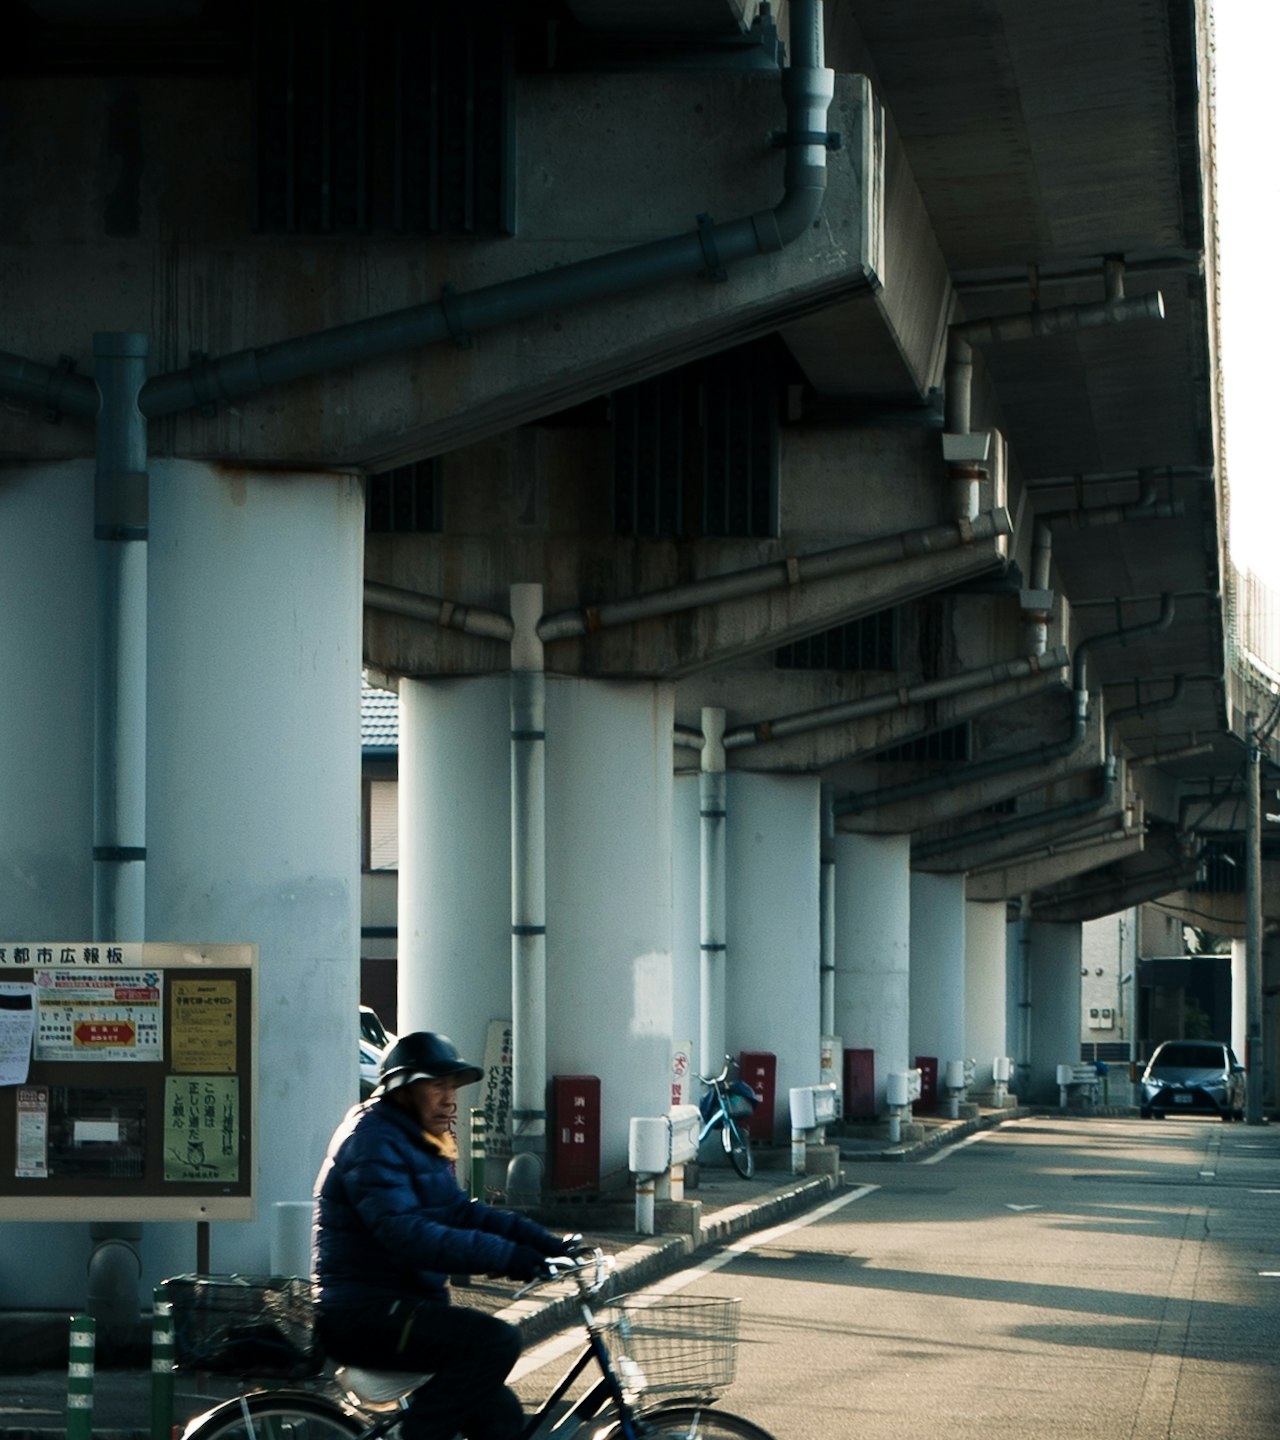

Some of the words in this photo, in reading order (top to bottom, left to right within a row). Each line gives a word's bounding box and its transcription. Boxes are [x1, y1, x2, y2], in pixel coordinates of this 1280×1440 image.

[188, 1082, 200, 1140] 正しい道だ
[204, 1082, 216, 1128] この道は
[574, 1096, 585, 1144] 消火器
